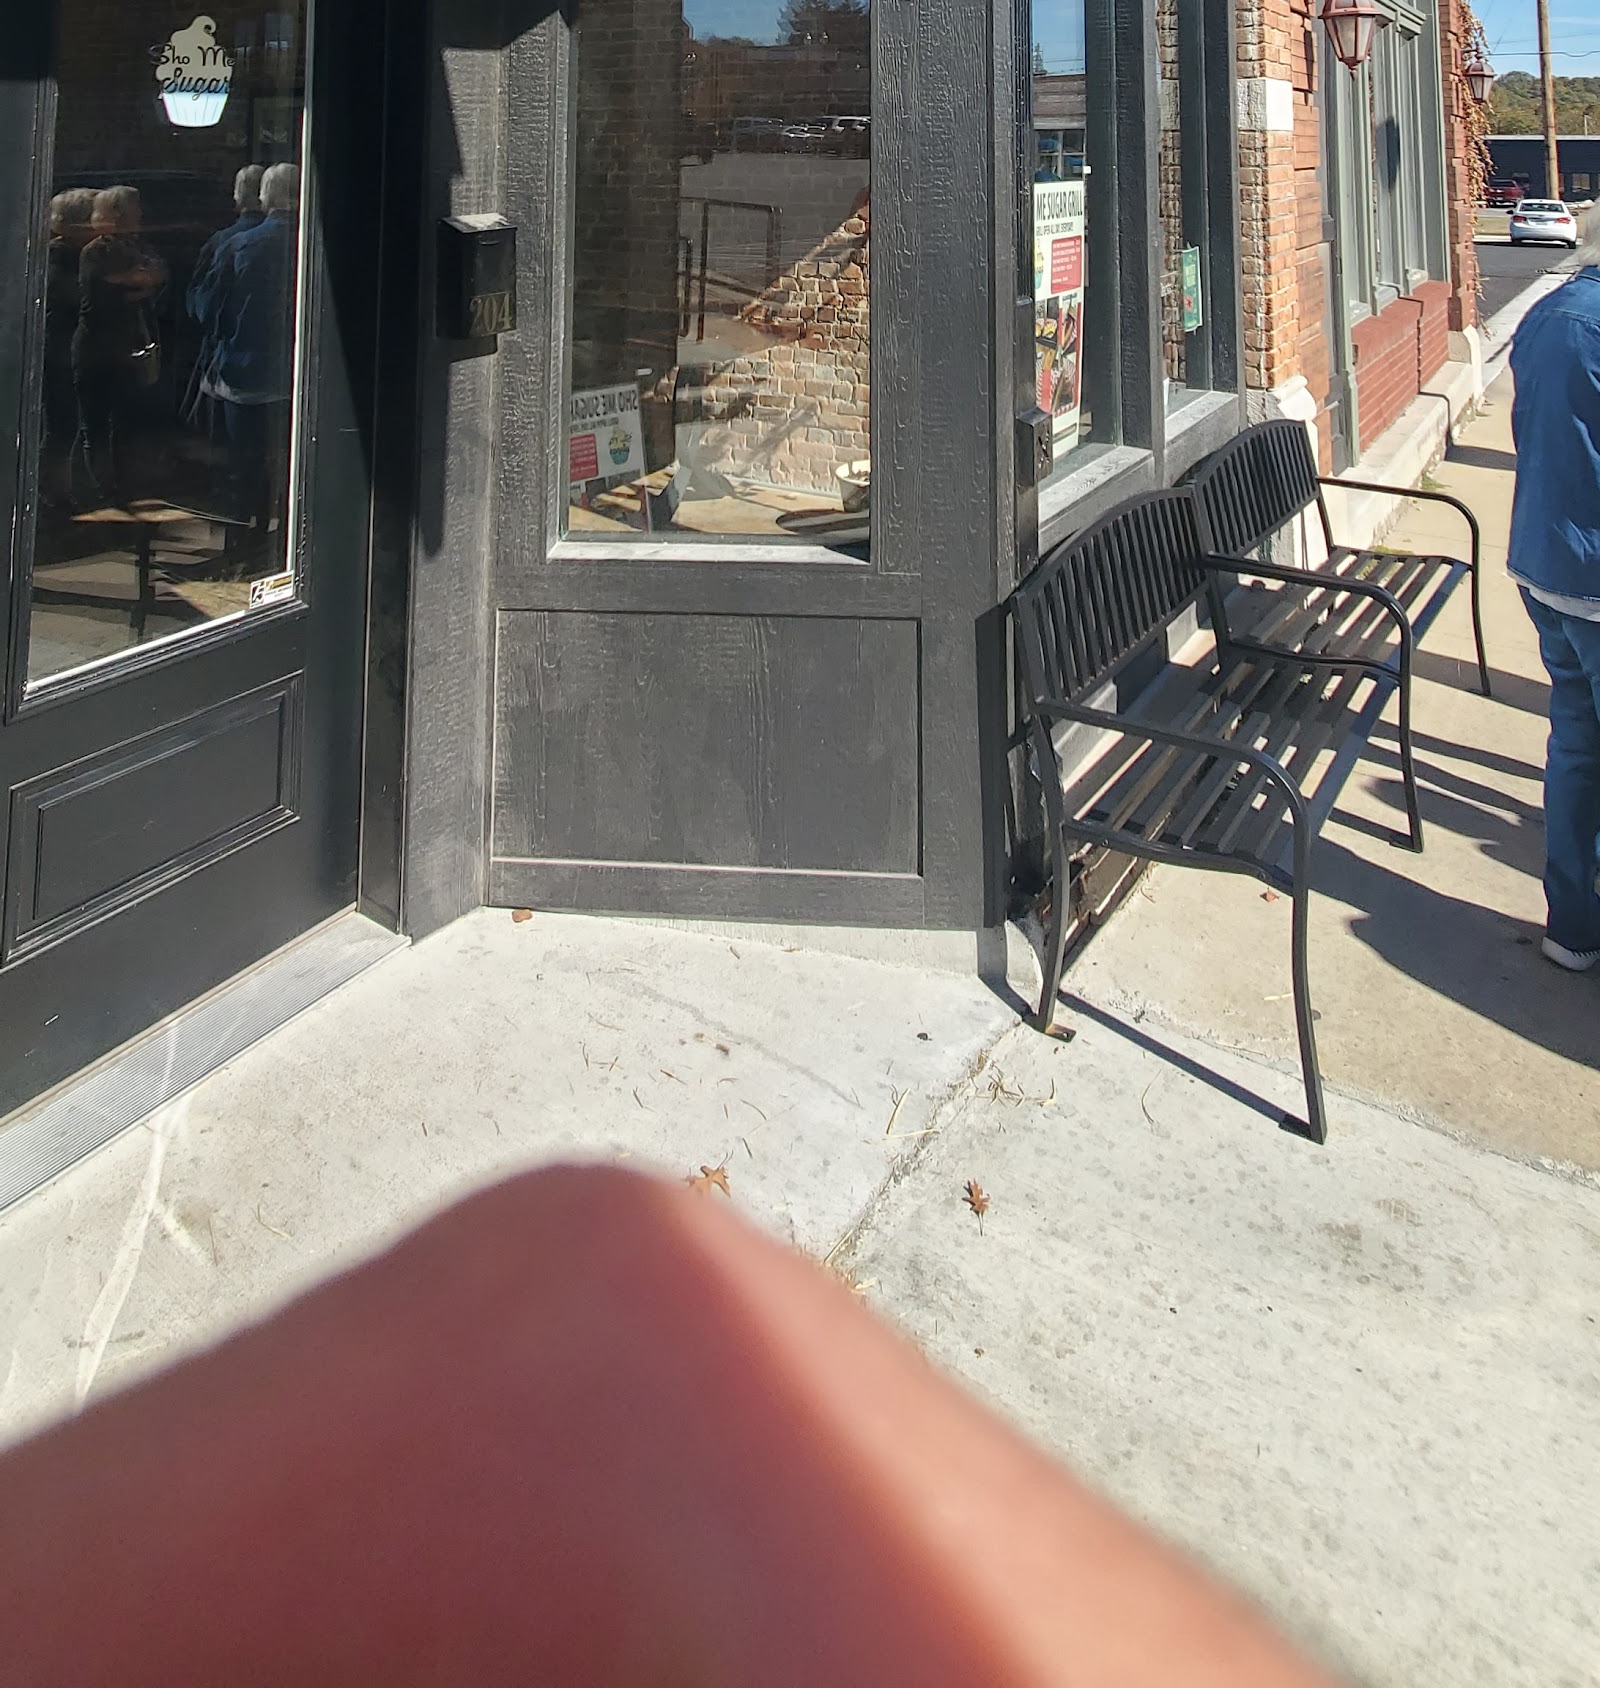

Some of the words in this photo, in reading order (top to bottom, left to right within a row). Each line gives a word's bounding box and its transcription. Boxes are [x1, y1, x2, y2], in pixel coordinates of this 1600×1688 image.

[198, 45, 235, 67] Me
[160, 67, 231, 101] Sugar
[1036, 193, 1046, 222] ME
[1047, 191, 1067, 220] SUGAR
[1068, 190, 1083, 217] GRILL
[469, 292, 512, 336] 204
